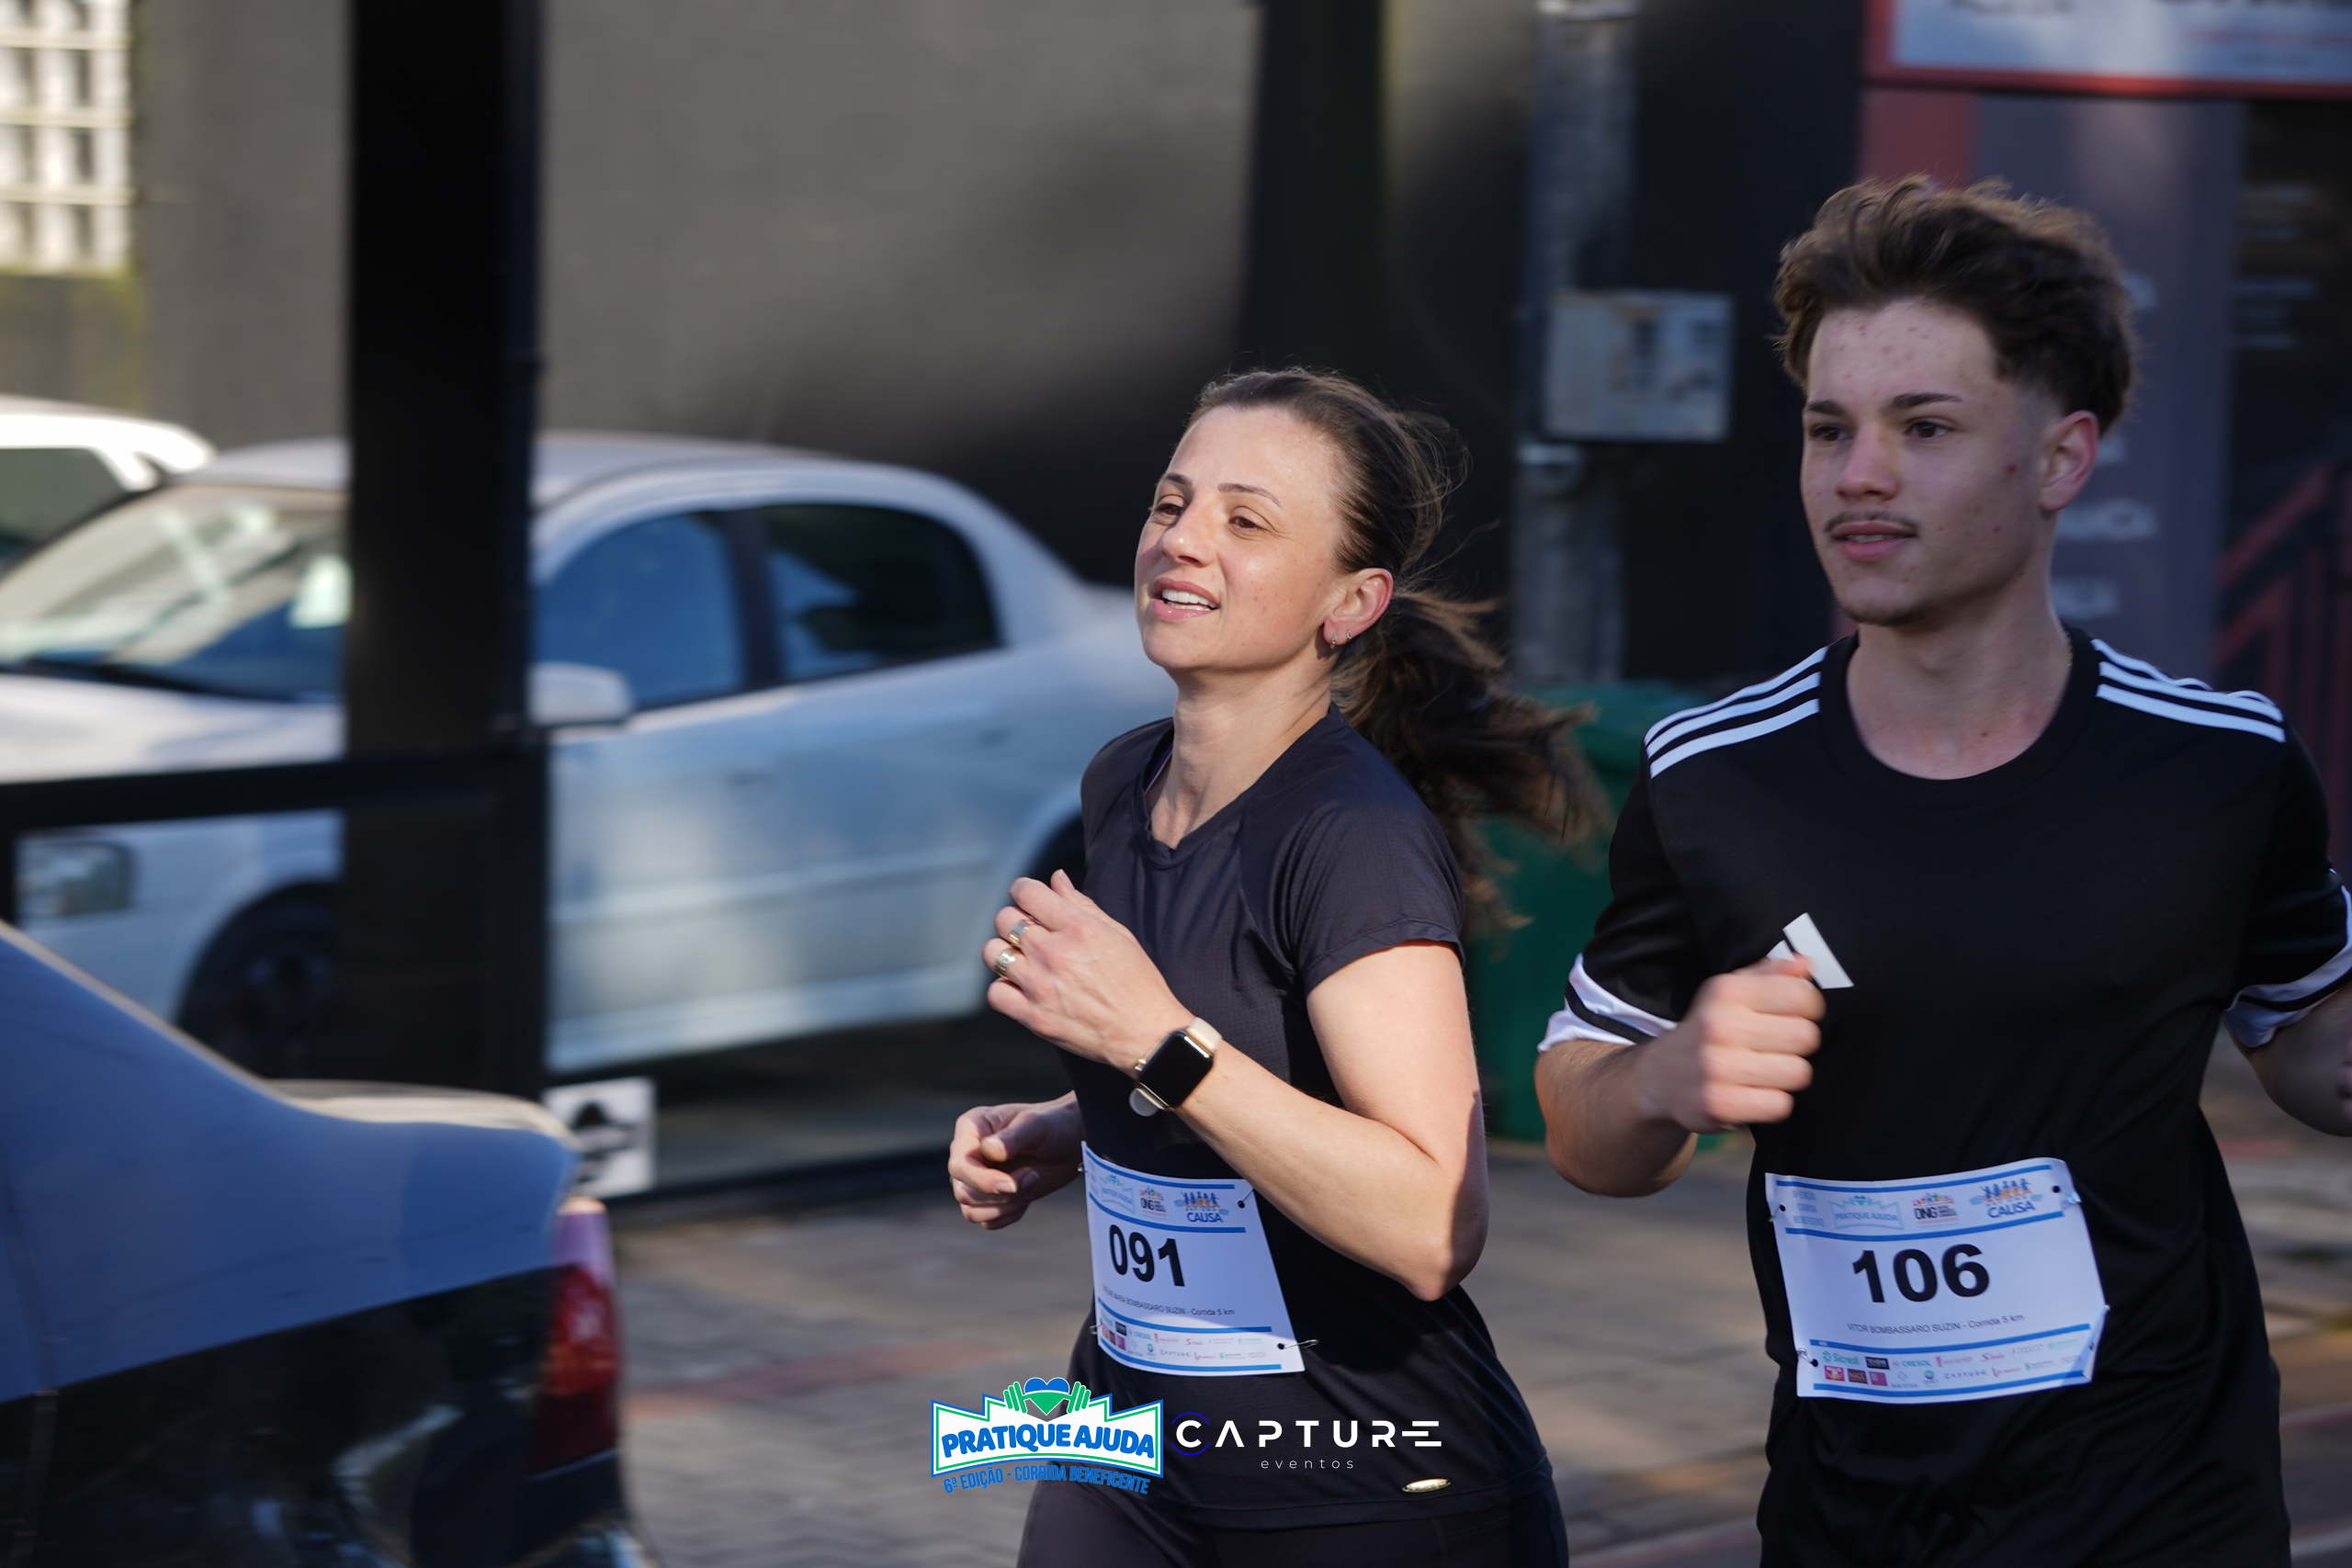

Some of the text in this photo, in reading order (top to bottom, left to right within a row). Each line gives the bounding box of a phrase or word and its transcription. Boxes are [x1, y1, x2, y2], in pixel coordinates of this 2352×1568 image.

[1140, 1197, 1155, 1211] ONG
[1987, 1201, 2036, 1218] CAUSA
[1186, 1213, 1224, 1223] CAUSA
[1835, 1212, 1899, 1222] PRATIQUE AJUDA
[1914, 1206, 1938, 1220] ONG
[1109, 1224, 1185, 1288] 091
[1852, 1244, 1990, 1303] 106
[1165, 1305, 1186, 1314] SUZIN
[1191, 1307, 1216, 1315] Corrida
[1847, 1322, 1869, 1333] VITOR
[1870, 1324, 1930, 1335] BOMBASSARO
[1932, 1321, 1962, 1332] SUZIN
[1968, 1316, 2001, 1329] Corrida
[2002, 1314, 2009, 1324] 5
[2010, 1314, 2025, 1323] km
[1902, 1359, 1932, 1368] CRESOL
